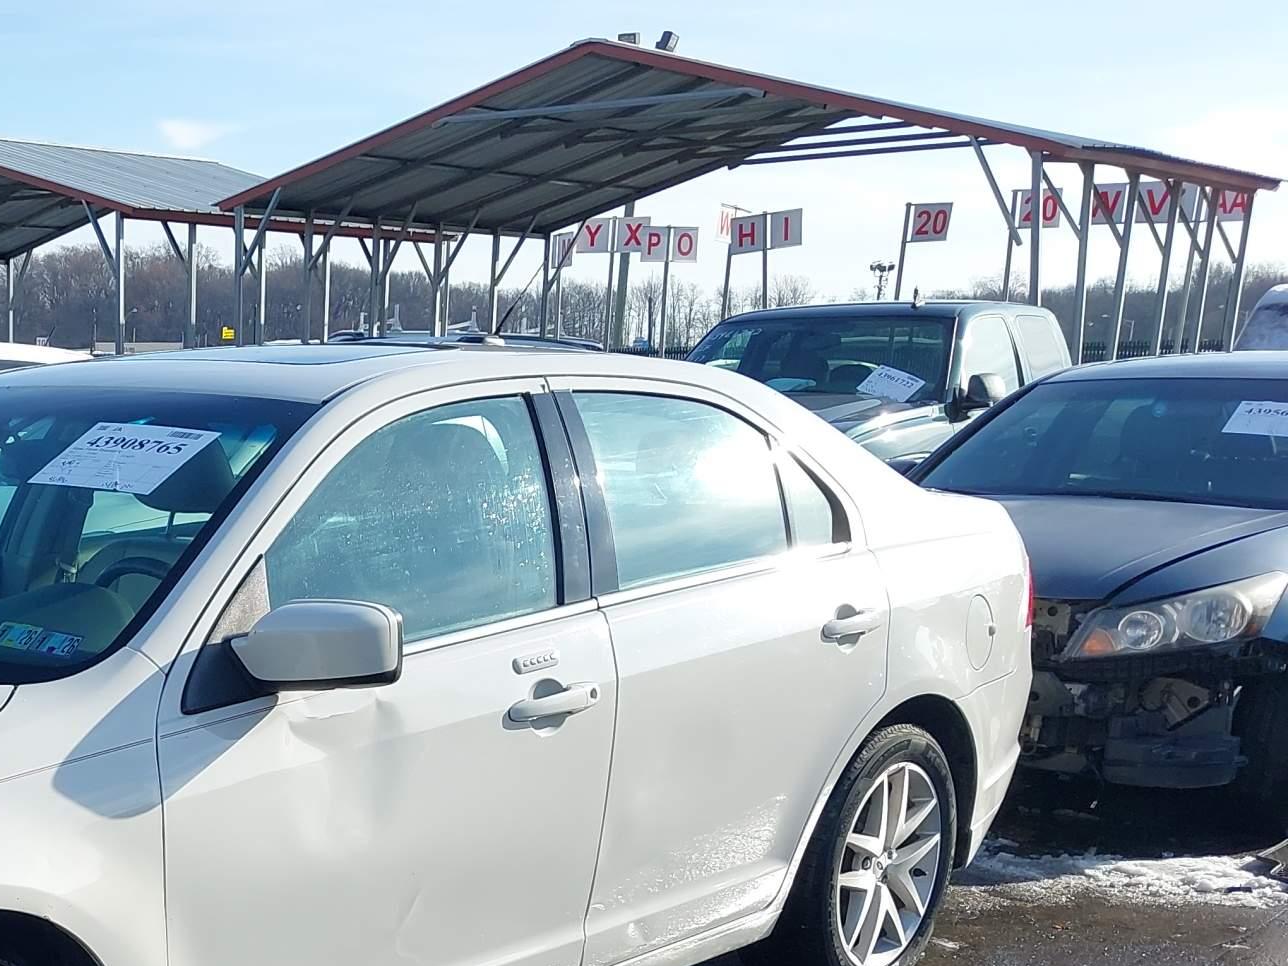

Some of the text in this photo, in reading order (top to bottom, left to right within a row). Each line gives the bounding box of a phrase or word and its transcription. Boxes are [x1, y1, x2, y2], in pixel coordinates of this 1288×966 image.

[1146, 188, 1170, 215] V
[585, 223, 603, 247] Y
[623, 222, 643, 247] X
[738, 221, 756, 248] H
[783, 216, 790, 241] I
[915, 209, 948, 236] 20
[647, 232, 662, 256] P
[677, 232, 694, 257] O
[86, 435, 188, 455] 43908765
